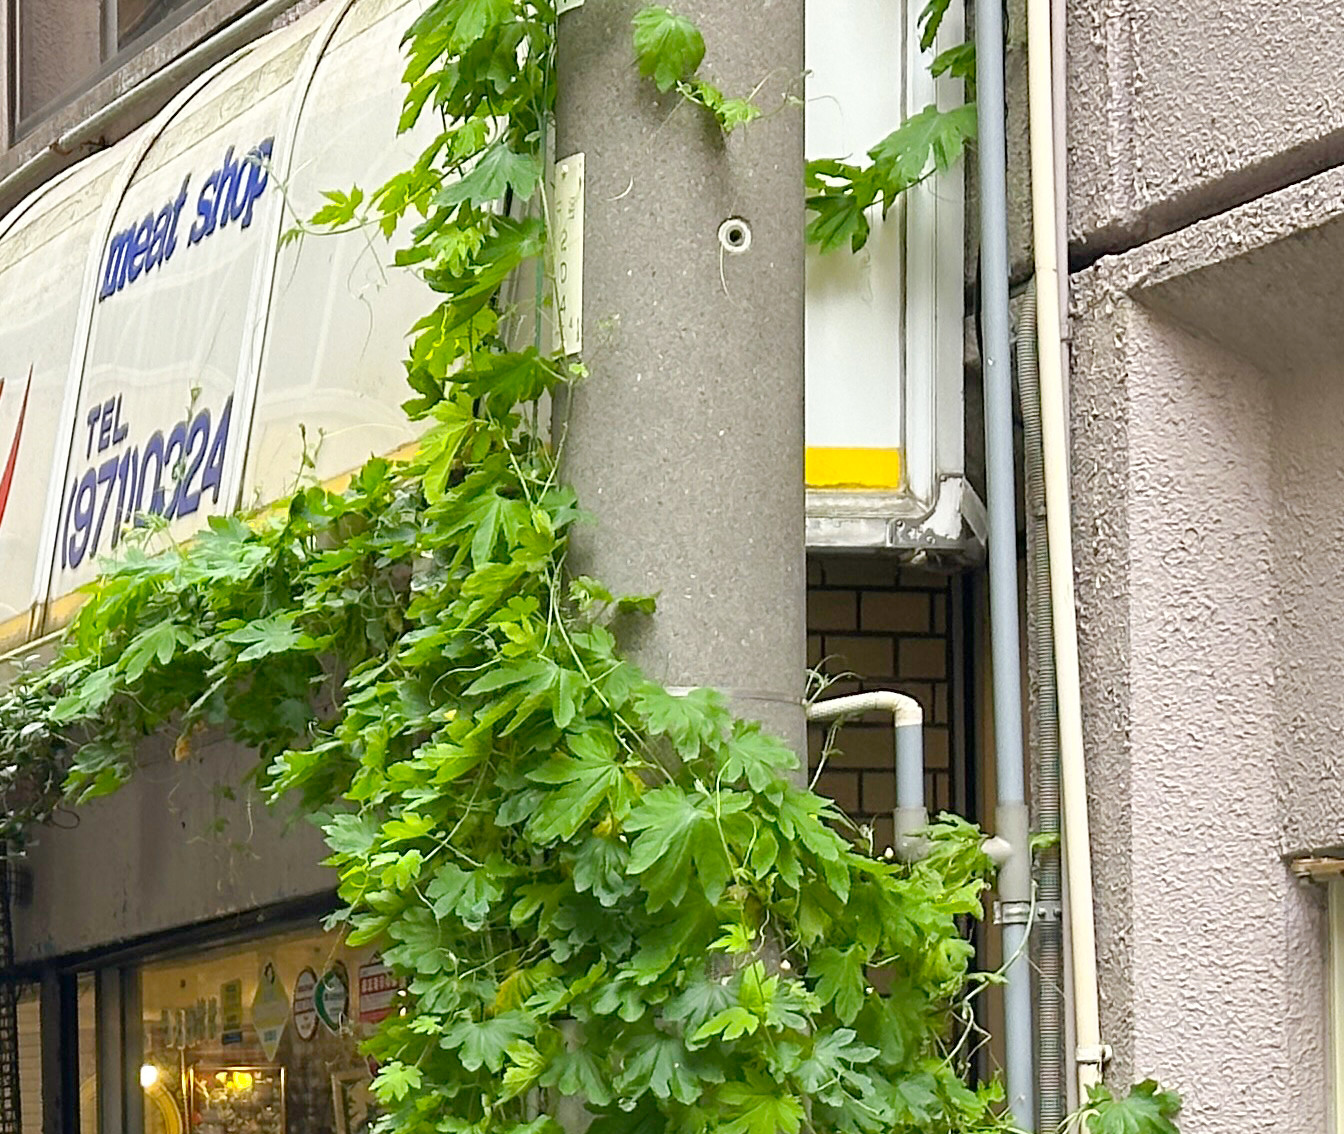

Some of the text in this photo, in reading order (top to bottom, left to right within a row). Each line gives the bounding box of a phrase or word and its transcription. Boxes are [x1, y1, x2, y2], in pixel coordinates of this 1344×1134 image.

[99, 136, 275, 302] meat shop
[61, 390, 234, 570] (971)0324
[87, 392, 129, 461] TEL
